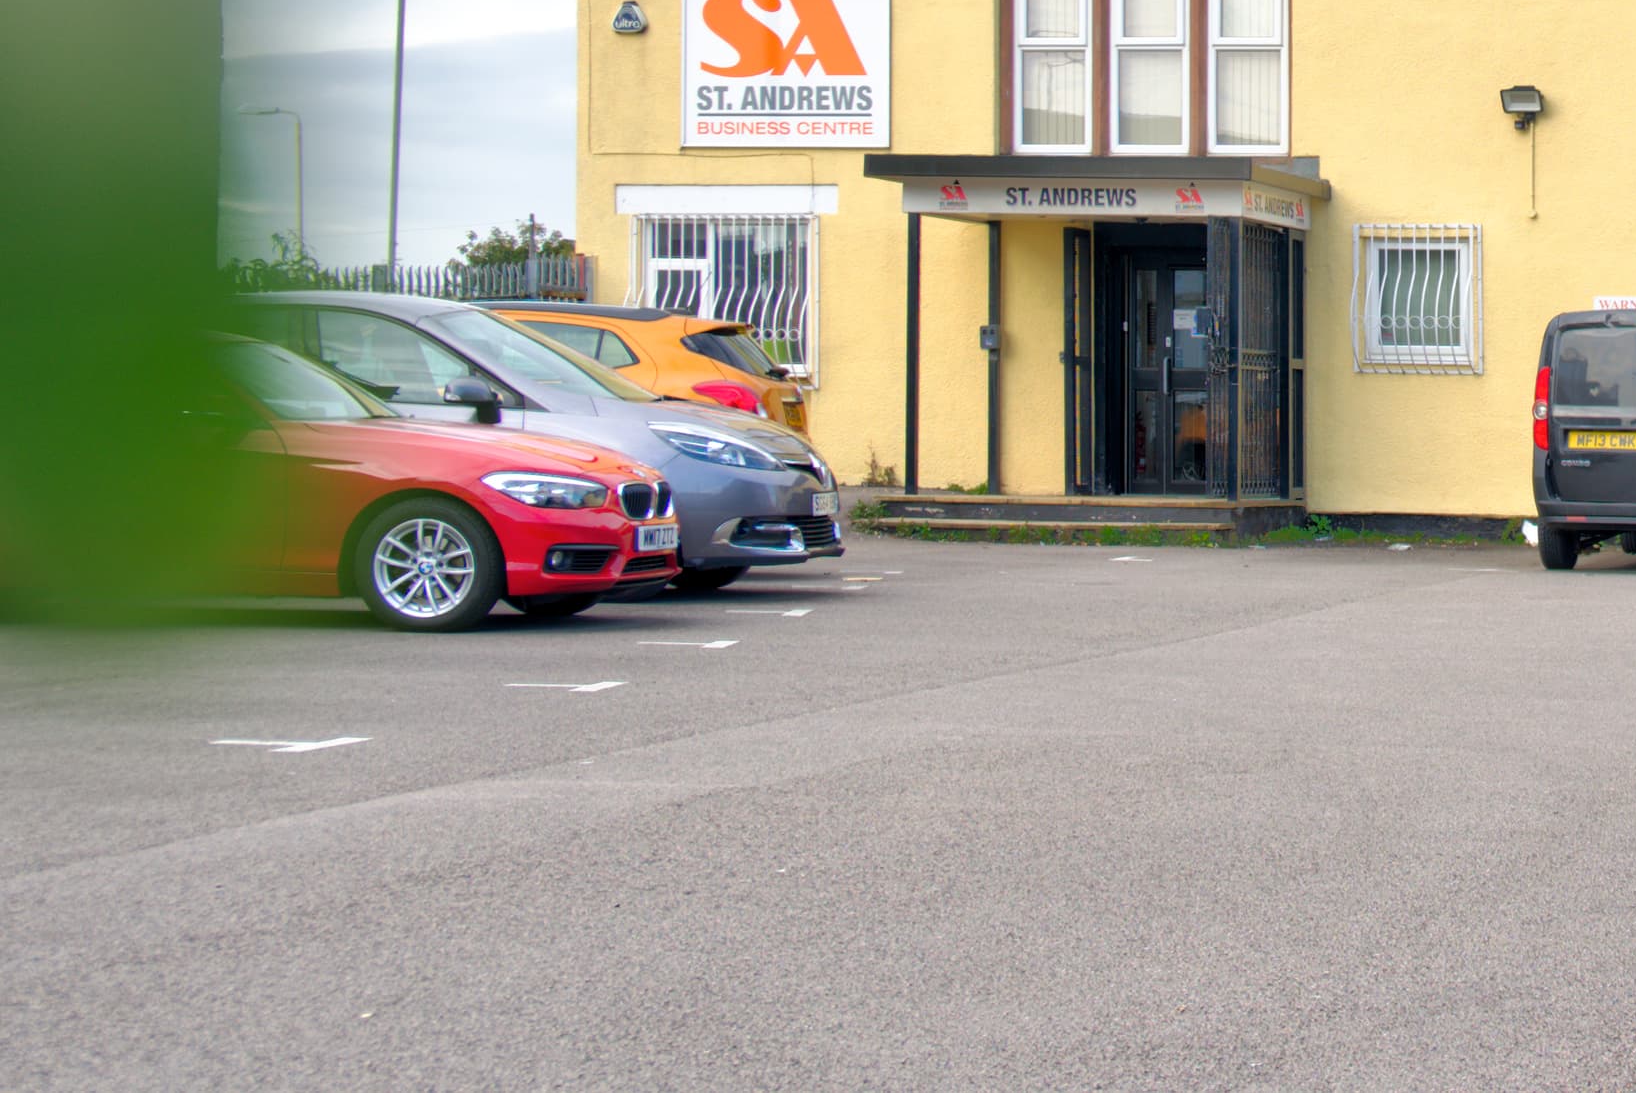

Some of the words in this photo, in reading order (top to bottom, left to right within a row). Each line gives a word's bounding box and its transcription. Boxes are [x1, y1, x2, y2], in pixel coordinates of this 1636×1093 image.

[697, 85, 733, 111] ST.
[740, 85, 873, 111] ANDREWS
[697, 121, 791, 135] BUSINESS
[797, 121, 873, 135] CENTRE
[1006, 187, 1032, 206] ST.
[1038, 187, 1137, 207] ANDREWS
